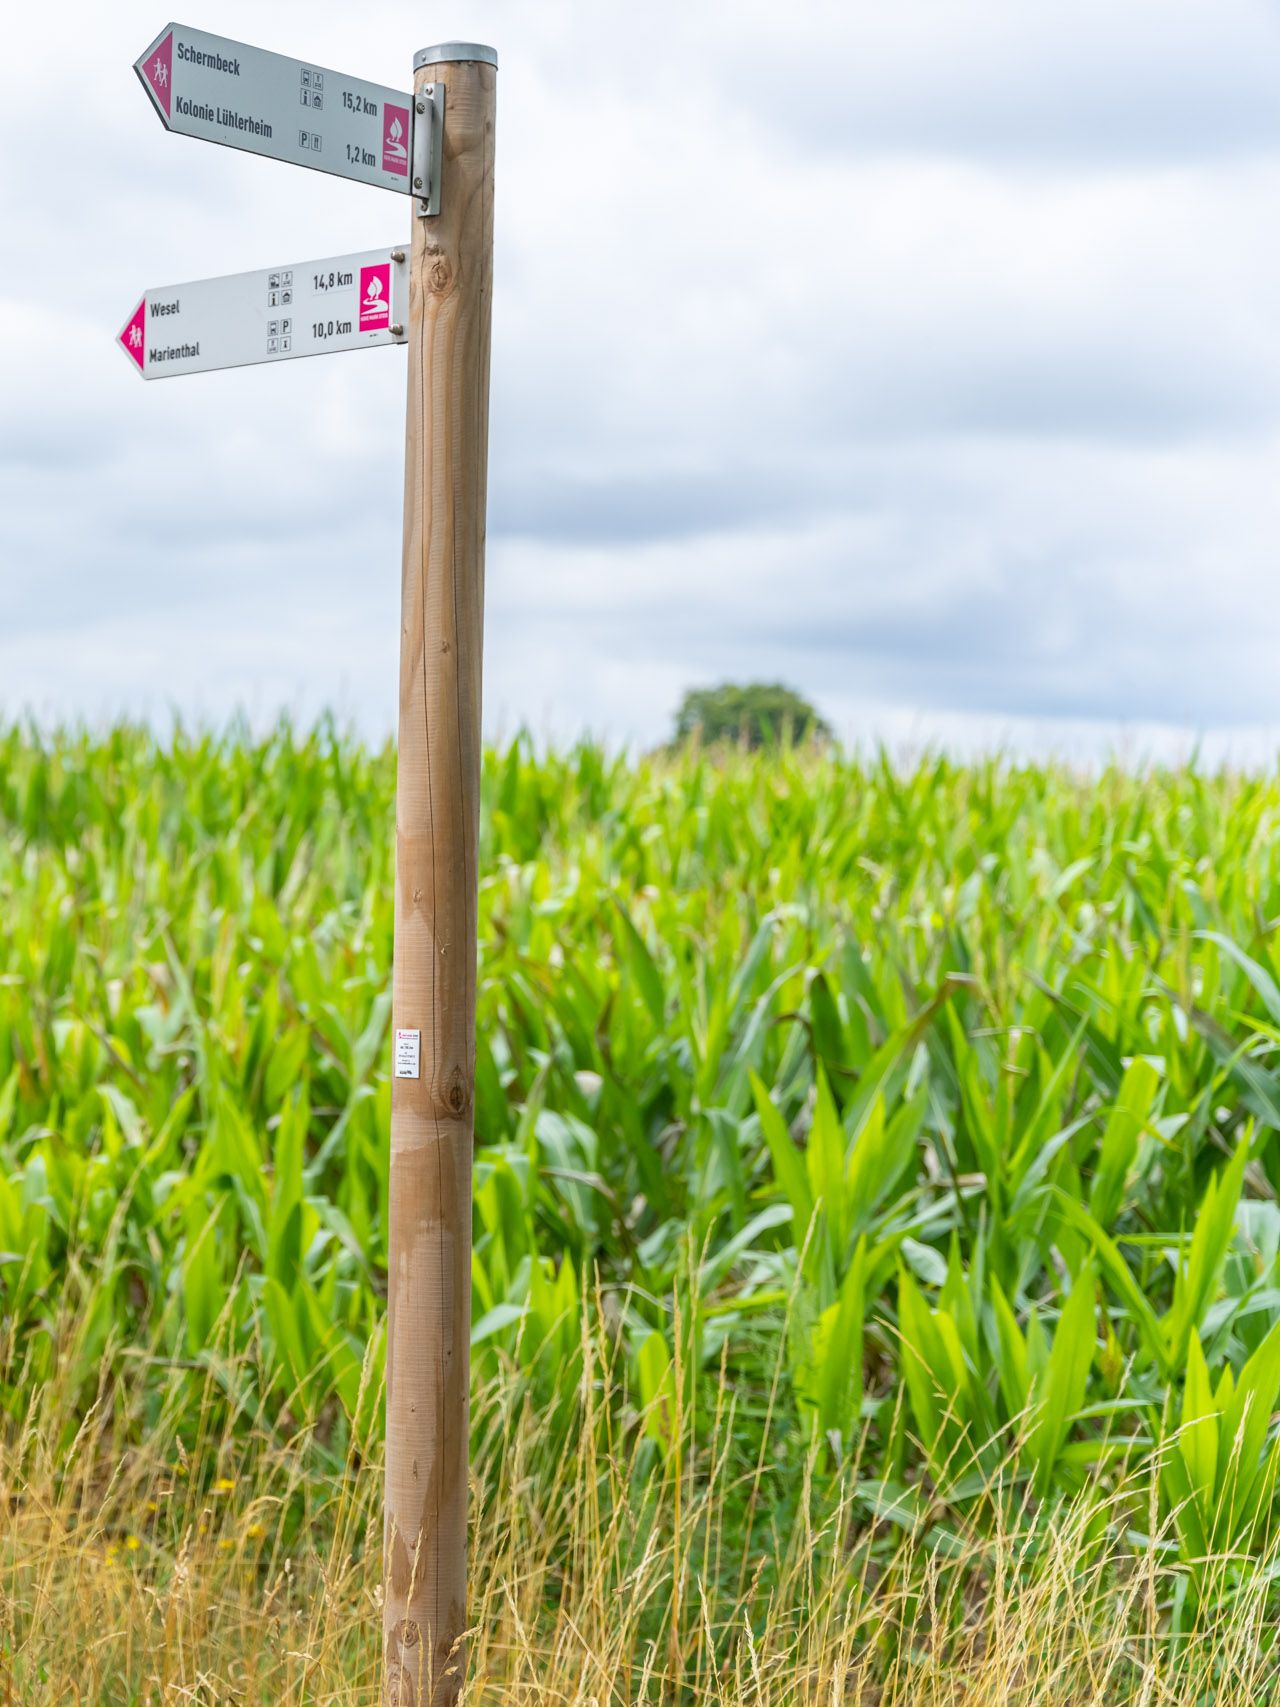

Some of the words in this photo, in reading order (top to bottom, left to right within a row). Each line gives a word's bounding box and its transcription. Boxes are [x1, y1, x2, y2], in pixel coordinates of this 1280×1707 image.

[177, 42, 240, 76] Schermbeck
[342, 91, 362, 113] 15,2
[363, 97, 378, 117] km
[175, 95, 214, 122] Kolonie
[216, 106, 273, 138] Lühlerheim
[346, 143, 360, 164] 1,2
[361, 147, 376, 167] km
[313, 272, 335, 291] 14,8
[337, 271, 353, 287] km
[150, 299, 180, 318] Wesel
[312, 321, 333, 339] 10,0
[336, 319, 352, 335] km
[149, 341, 200, 363] Marienthal
